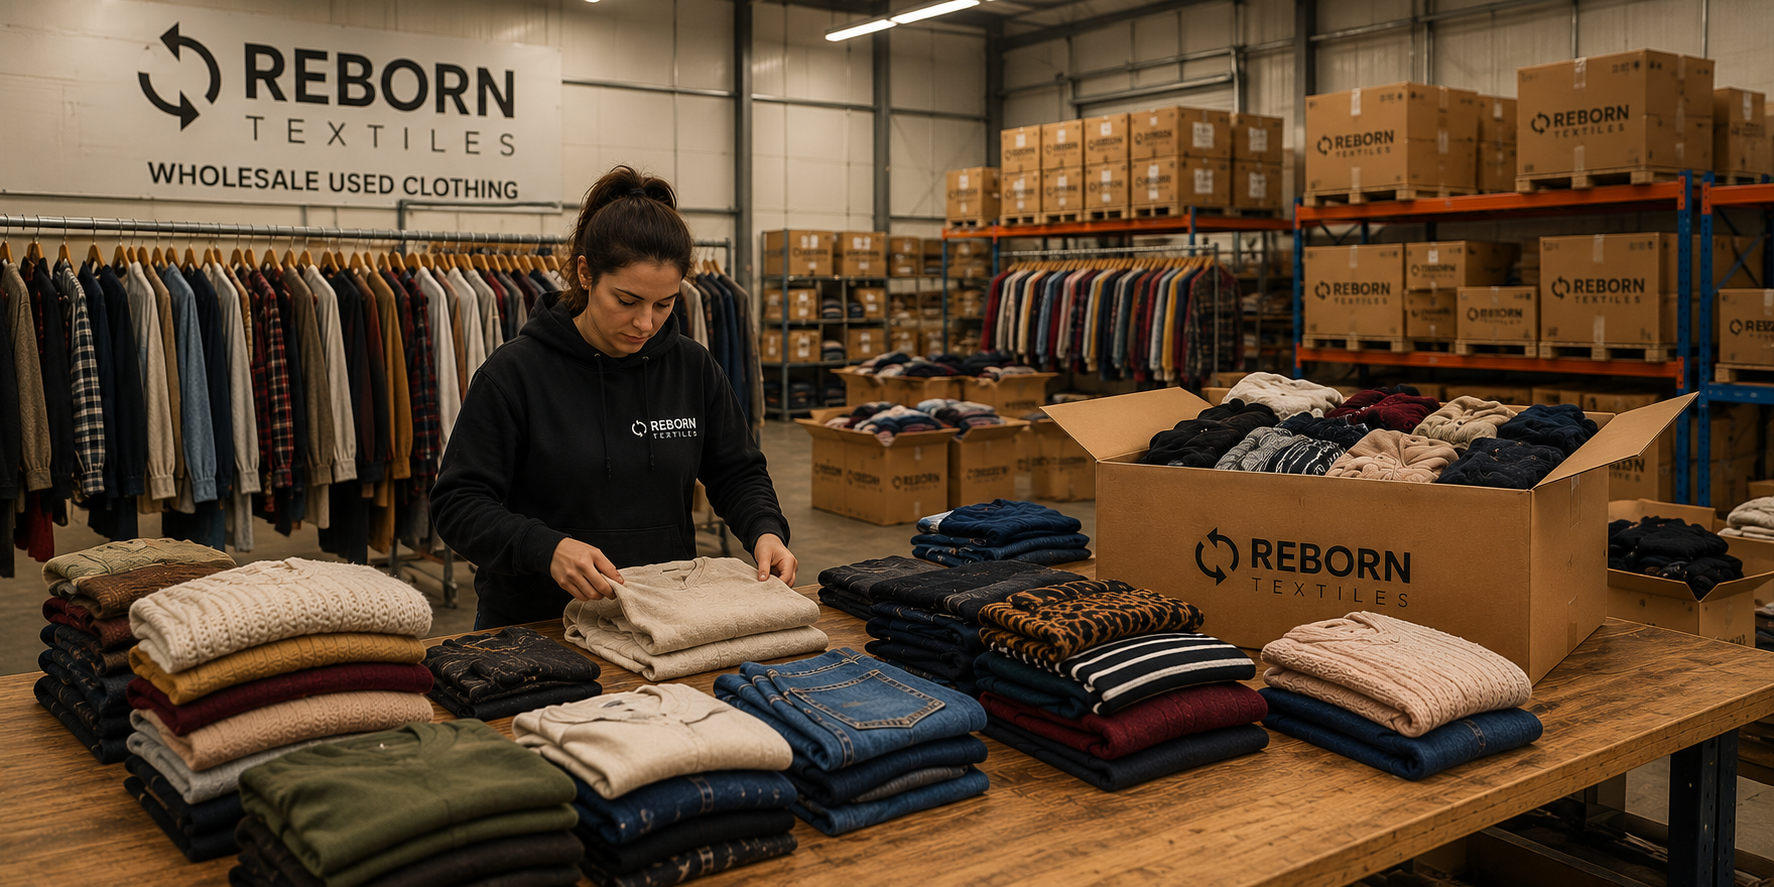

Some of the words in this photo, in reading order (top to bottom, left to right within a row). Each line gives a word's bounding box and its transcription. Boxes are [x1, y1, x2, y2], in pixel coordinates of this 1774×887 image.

[244, 43, 515, 118] REBORN
[1554, 104, 1630, 128] REBORN
[245, 115, 516, 156] TEXTILES
[1335, 130, 1395, 149] REBORN
[1554, 123, 1626, 139] TEXTILES
[147, 161, 319, 191] WHOLESALE
[328, 172, 395, 194] USED
[402, 176, 519, 200] CLOTHING
[1333, 282, 1391, 296] REBORN
[1573, 278, 1645, 294] REBORN
[650, 418, 696, 431] REBORN
[1251, 538, 1411, 584] REBORN
[1251, 577, 1408, 608] TEXTILES
